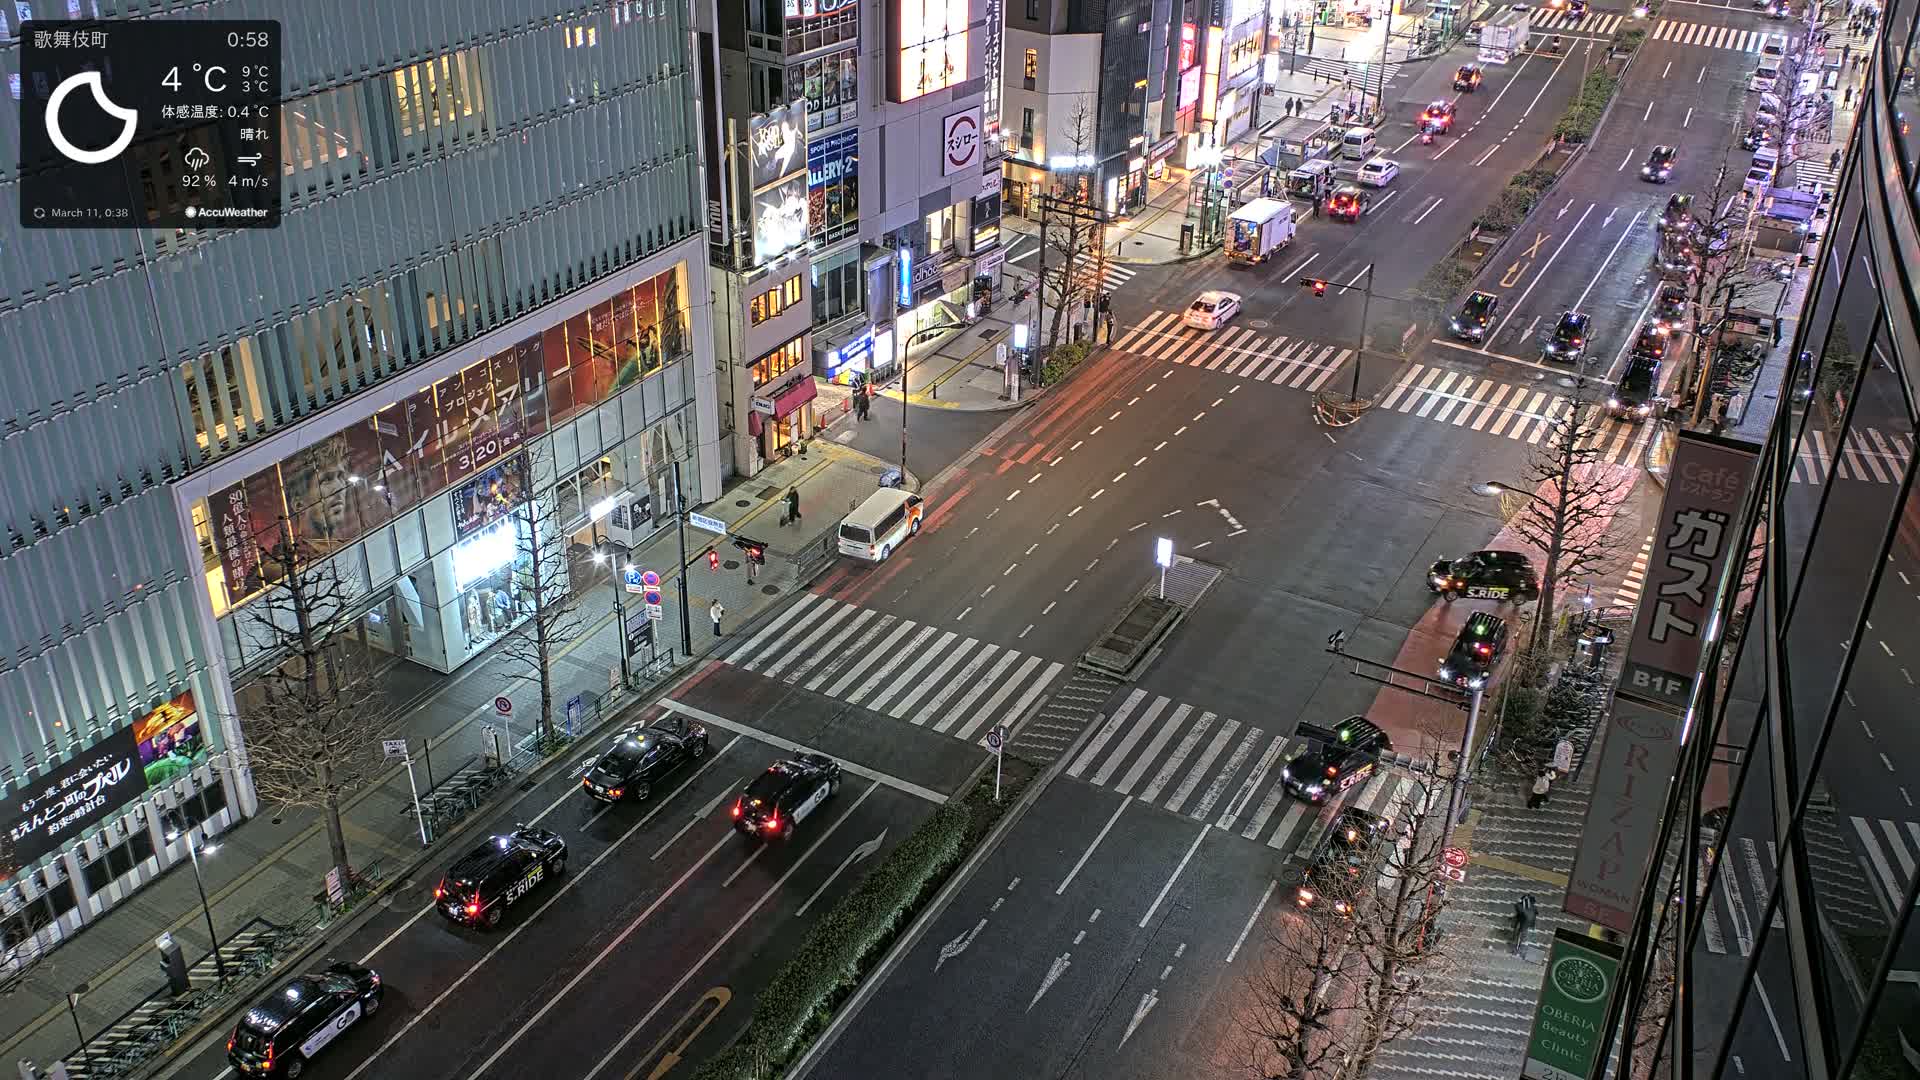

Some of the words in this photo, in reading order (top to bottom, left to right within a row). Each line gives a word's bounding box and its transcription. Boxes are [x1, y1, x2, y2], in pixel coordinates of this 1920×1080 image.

[947, 133, 979, 151] スシロー
[709, 200, 721, 233] MUJI
[408, 341, 540, 413] ライアン・ゴズリング
[445, 377, 504, 412] プロジェクト
[459, 440, 497, 470] 3.20
[1681, 462, 1740, 489] Café
[1650, 510, 1727, 643] ガスト
[1466, 589, 1509, 600] S.RIDE
[1632, 670, 1682, 696] B1F
[22, 753, 114, 812] もう一度、君に会いたい
[19, 757, 131, 840] えんとつ町のプペル
[1597, 743, 1650, 881] RIZAP
[48, 794, 107, 836] 約束の時計台
[506, 868, 544, 905] S.RIDE
[1577, 878, 1632, 905] WOMAN
[336, 1009, 356, 1030] GO
[1541, 1004, 1597, 1033] OBERIA
[1541, 1020, 1587, 1047] Beauty
[1540, 1039, 1583, 1062] Clinic
